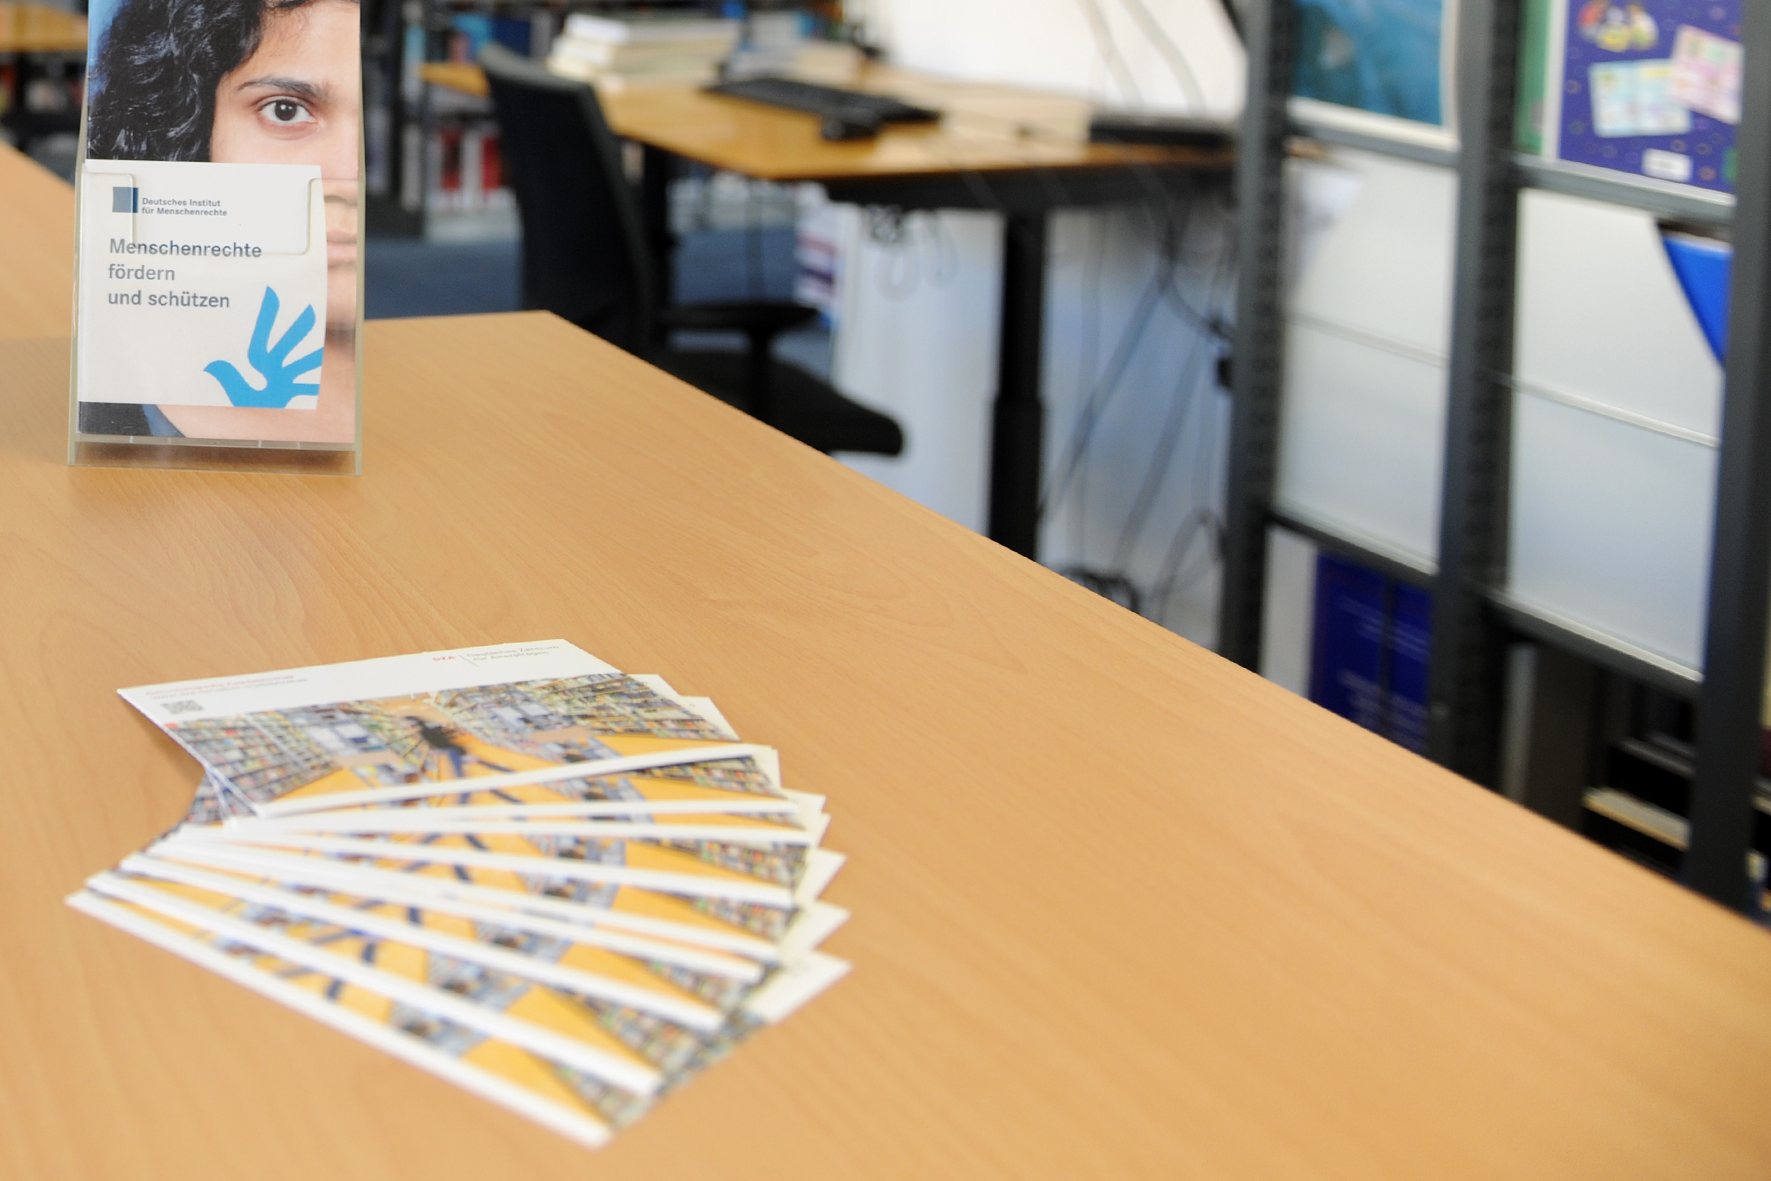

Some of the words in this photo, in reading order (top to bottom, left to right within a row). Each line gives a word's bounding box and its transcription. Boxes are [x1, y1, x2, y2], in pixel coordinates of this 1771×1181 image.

[142, 198, 187, 206] Deutsches
[190, 199, 221, 207] Institut
[157, 208, 227, 216] Menschenrechte
[109, 238, 262, 258] Menschenrechte
[108, 264, 176, 281] fördern
[108, 290, 141, 305] und
[148, 291, 230, 308] schützen
